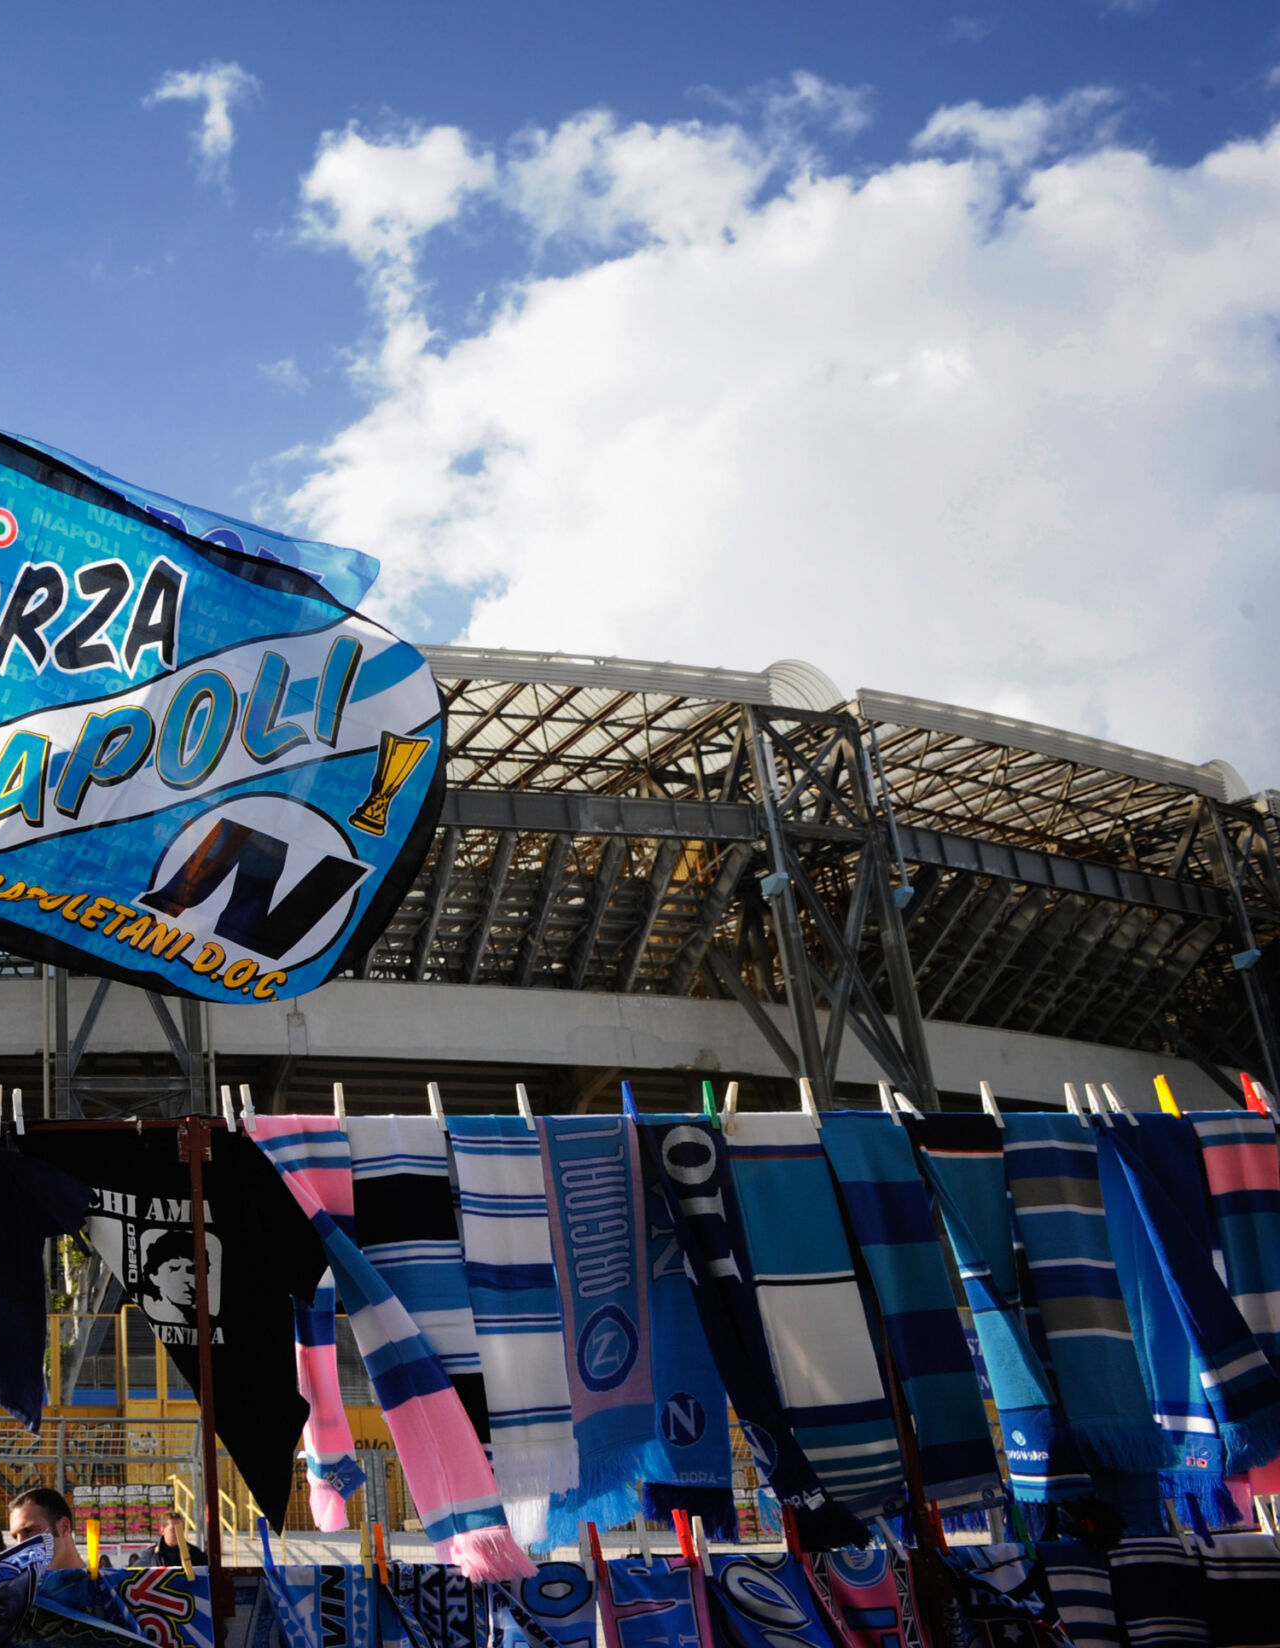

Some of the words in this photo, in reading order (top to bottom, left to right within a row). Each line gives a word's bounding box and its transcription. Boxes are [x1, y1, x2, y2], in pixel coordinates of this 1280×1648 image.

[30, 506, 121, 557] NAPOLI
[140, 817, 368, 960] N
[88, 1187, 137, 1218] CHI
[559, 1145, 631, 1299] ORIGINAL
